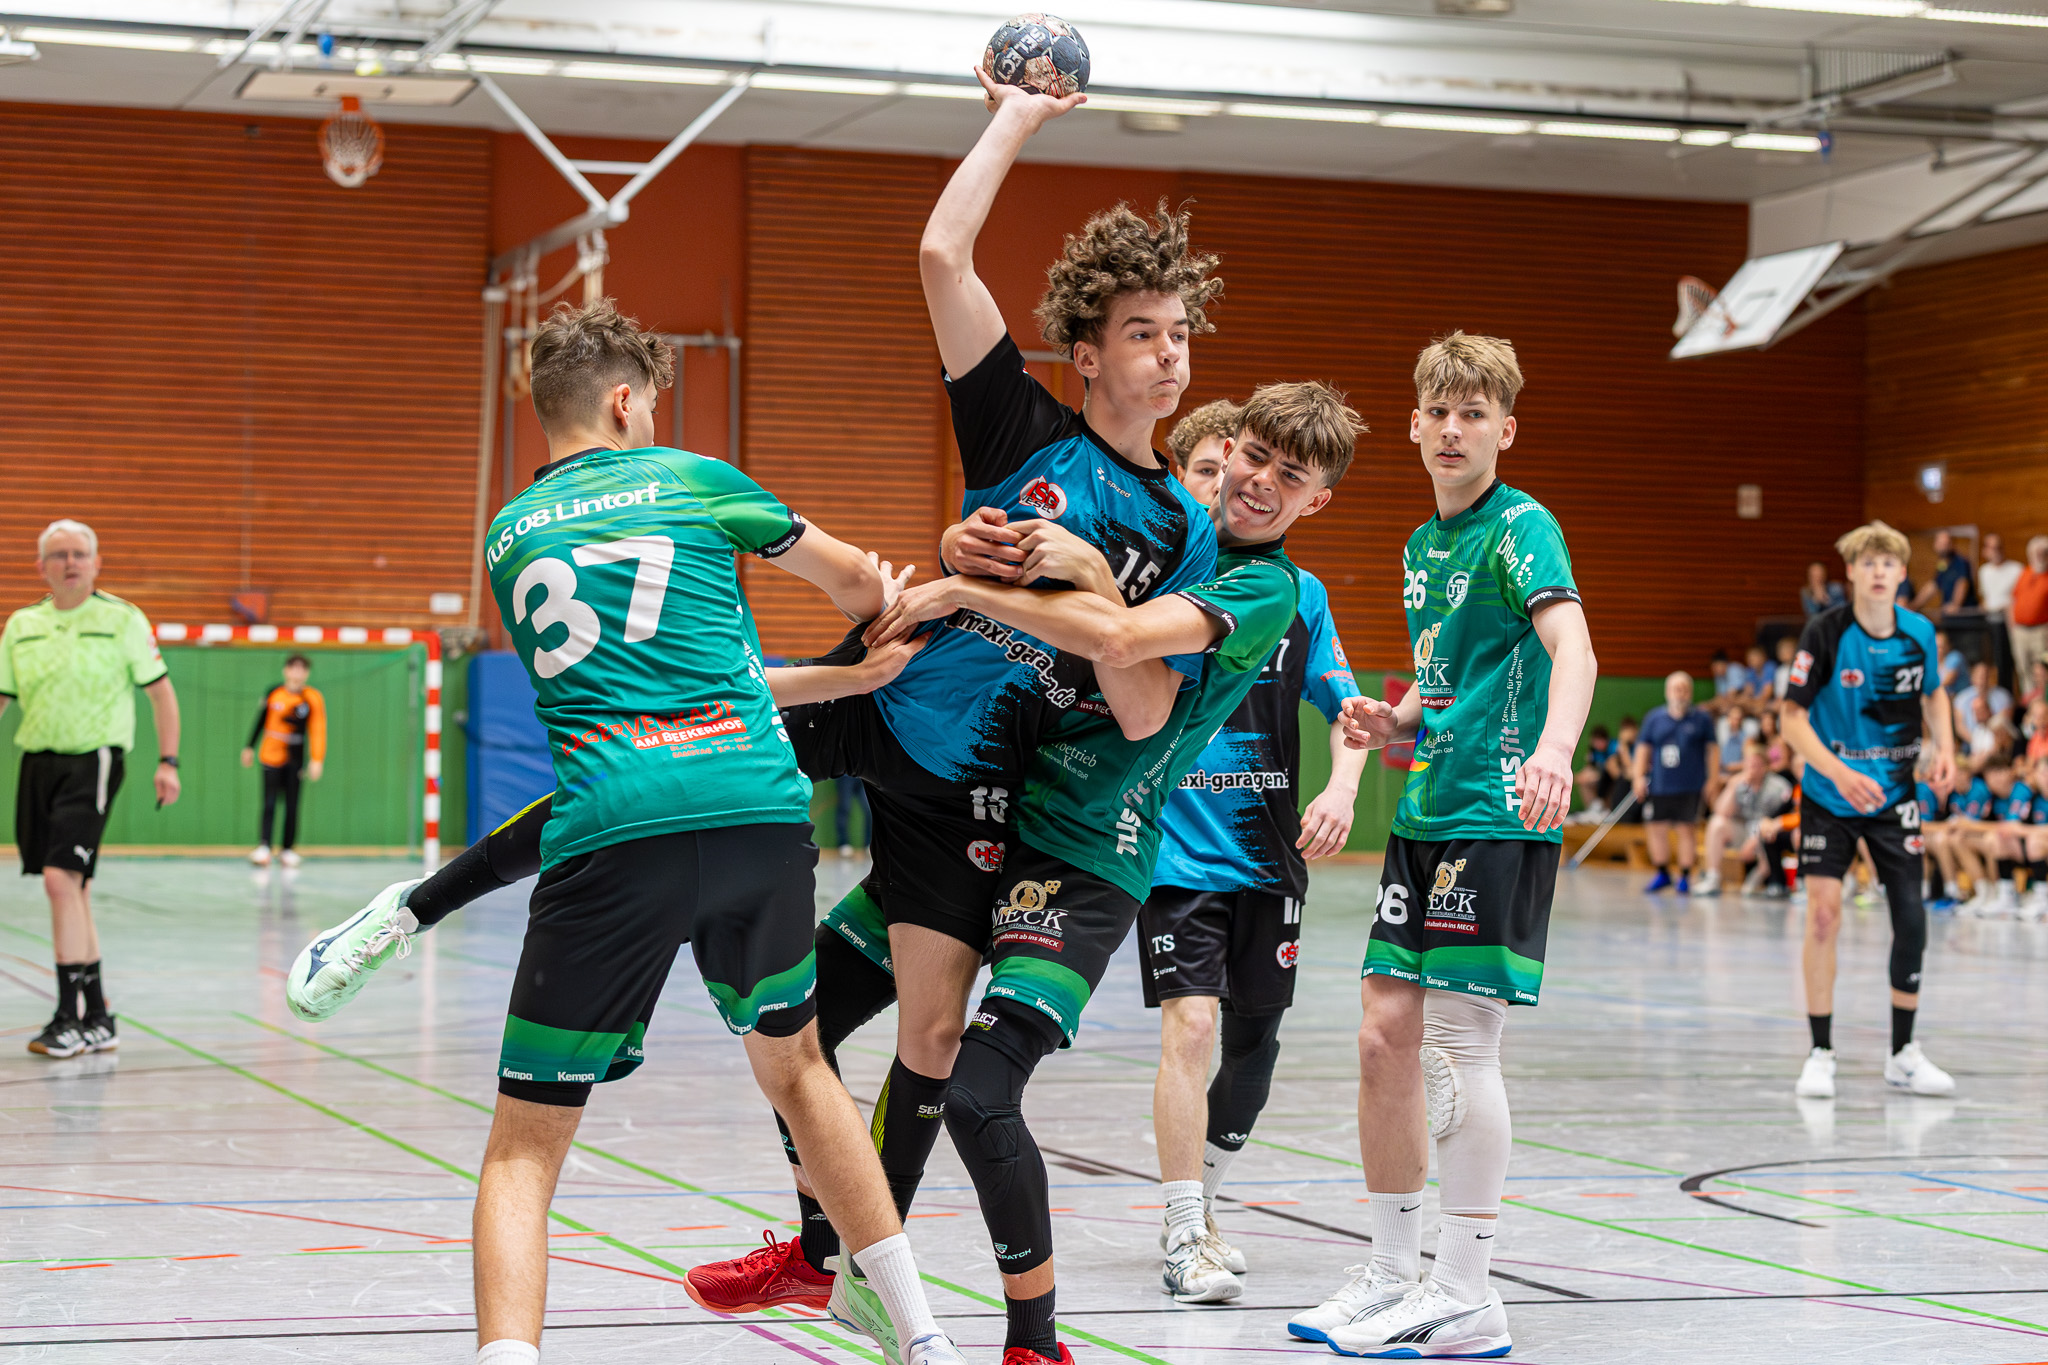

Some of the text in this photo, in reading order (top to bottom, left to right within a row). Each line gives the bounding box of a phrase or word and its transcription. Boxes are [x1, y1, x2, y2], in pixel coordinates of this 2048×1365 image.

[1107, 480, 1132, 499] spized
[515, 508, 551, 536] 08
[555, 481, 660, 520] Lintorf
[765, 534, 797, 555] Kempa
[1427, 547, 1450, 561] Kempa
[1114, 547, 1161, 600] 15
[1403, 569, 1428, 610] 26
[1526, 590, 1552, 608] Kempa
[512, 535, 675, 679] 37
[1895, 665, 1924, 693] 27
[1080, 701, 1113, 716] ins MEC
[636, 719, 743, 749] AM BEEKERHOF
[1144, 749, 1172, 780] Zentrum
[839, 922, 867, 949] Kempa
[1457, 923, 1475, 932] MECK
[1038, 936, 1060, 947] MECK
[1152, 934, 1176, 954] TS
[1390, 967, 1419, 981] Kempa
[1426, 975, 1449, 987] Kempa
[1467, 982, 1498, 996] Kempa
[759, 1001, 788, 1014] Kempa
[1036, 997, 1062, 1023] Kempa
[502, 1067, 533, 1080] Kempa
[557, 1071, 595, 1082] Kempa
